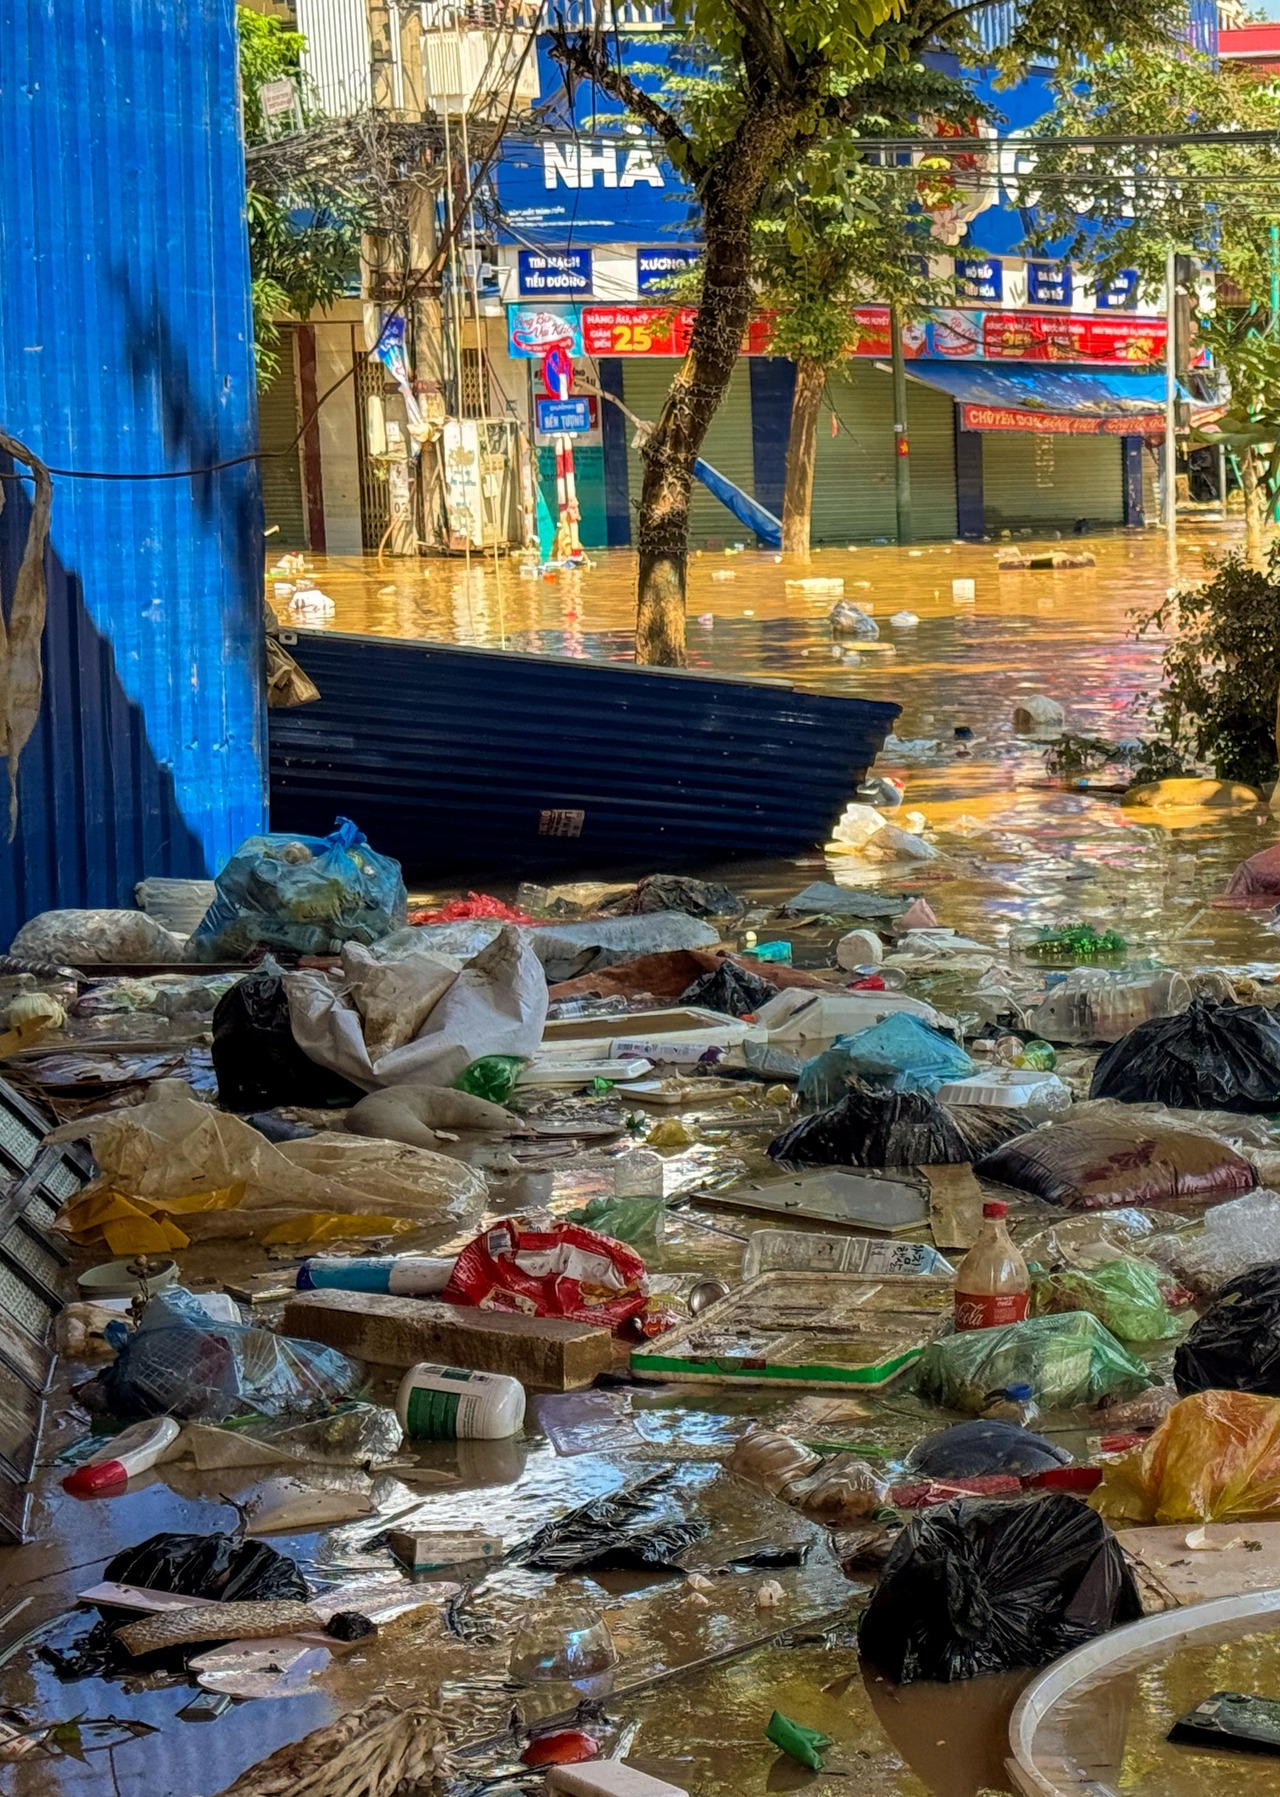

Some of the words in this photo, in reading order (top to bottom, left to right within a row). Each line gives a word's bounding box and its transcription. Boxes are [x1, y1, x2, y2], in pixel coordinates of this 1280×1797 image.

[528, 257, 546, 269] TIM
[525, 271, 545, 288] TIỂU
[587, 312, 614, 325] HÀNG
